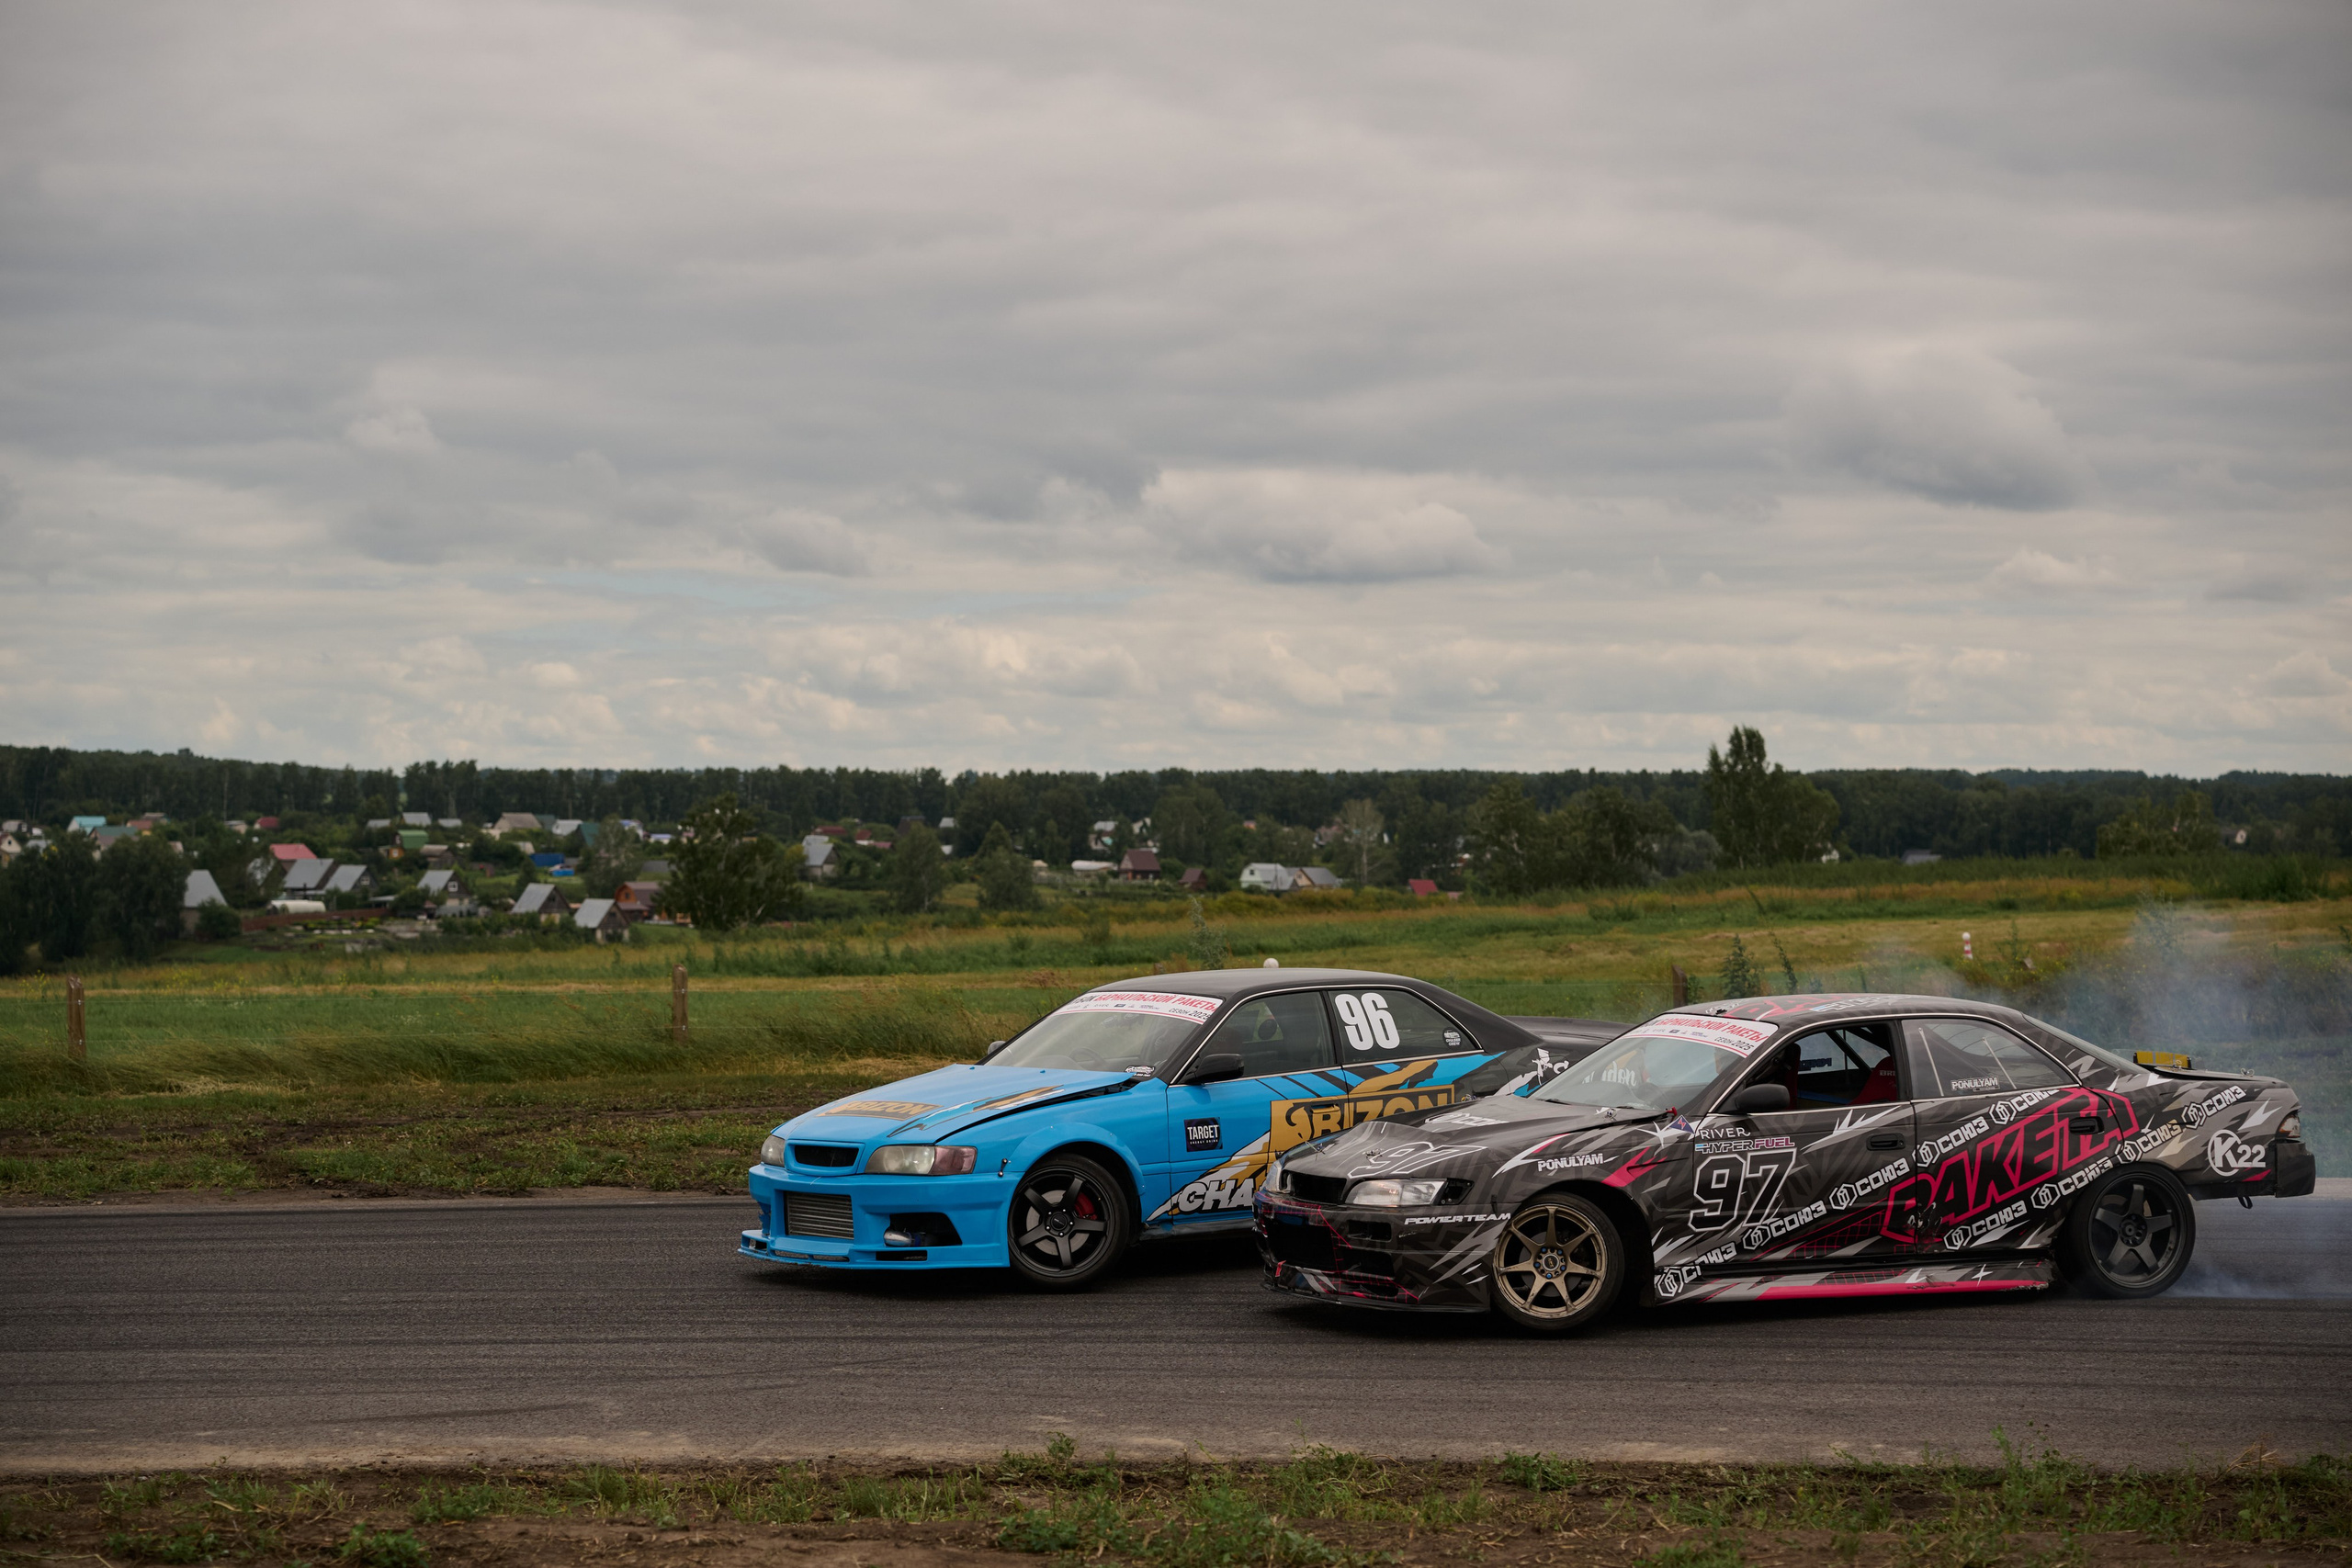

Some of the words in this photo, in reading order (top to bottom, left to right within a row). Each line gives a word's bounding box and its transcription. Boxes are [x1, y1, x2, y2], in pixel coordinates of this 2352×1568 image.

[1334, 992, 1400, 1051] 96
[1722, 1023, 1770, 1043] РАКЕТЫ
[1731, 1039, 1755, 1051] 2025
[1951, 1077, 1998, 1090] PONULYAM
[1187, 1124, 1219, 1140] TARGET
[1700, 1127, 1751, 1139] RIVER
[1347, 1141, 1488, 1179] 97
[1537, 1153, 1604, 1172] PONULYAM
[1973, 1201, 2028, 1237] СОЮЗ
[2202, 1085, 2247, 1117] СОЮЗ
[2212, 1134, 2267, 1169] K22
[1688, 1148, 1797, 1233] 97
[1771, 1201, 1827, 1238] СОЮЗ
[1858, 1157, 1909, 1197] СОЮЗ
[1939, 1116, 1990, 1154] СОЮЗ
[1178, 1178, 1255, 1213] CHA
